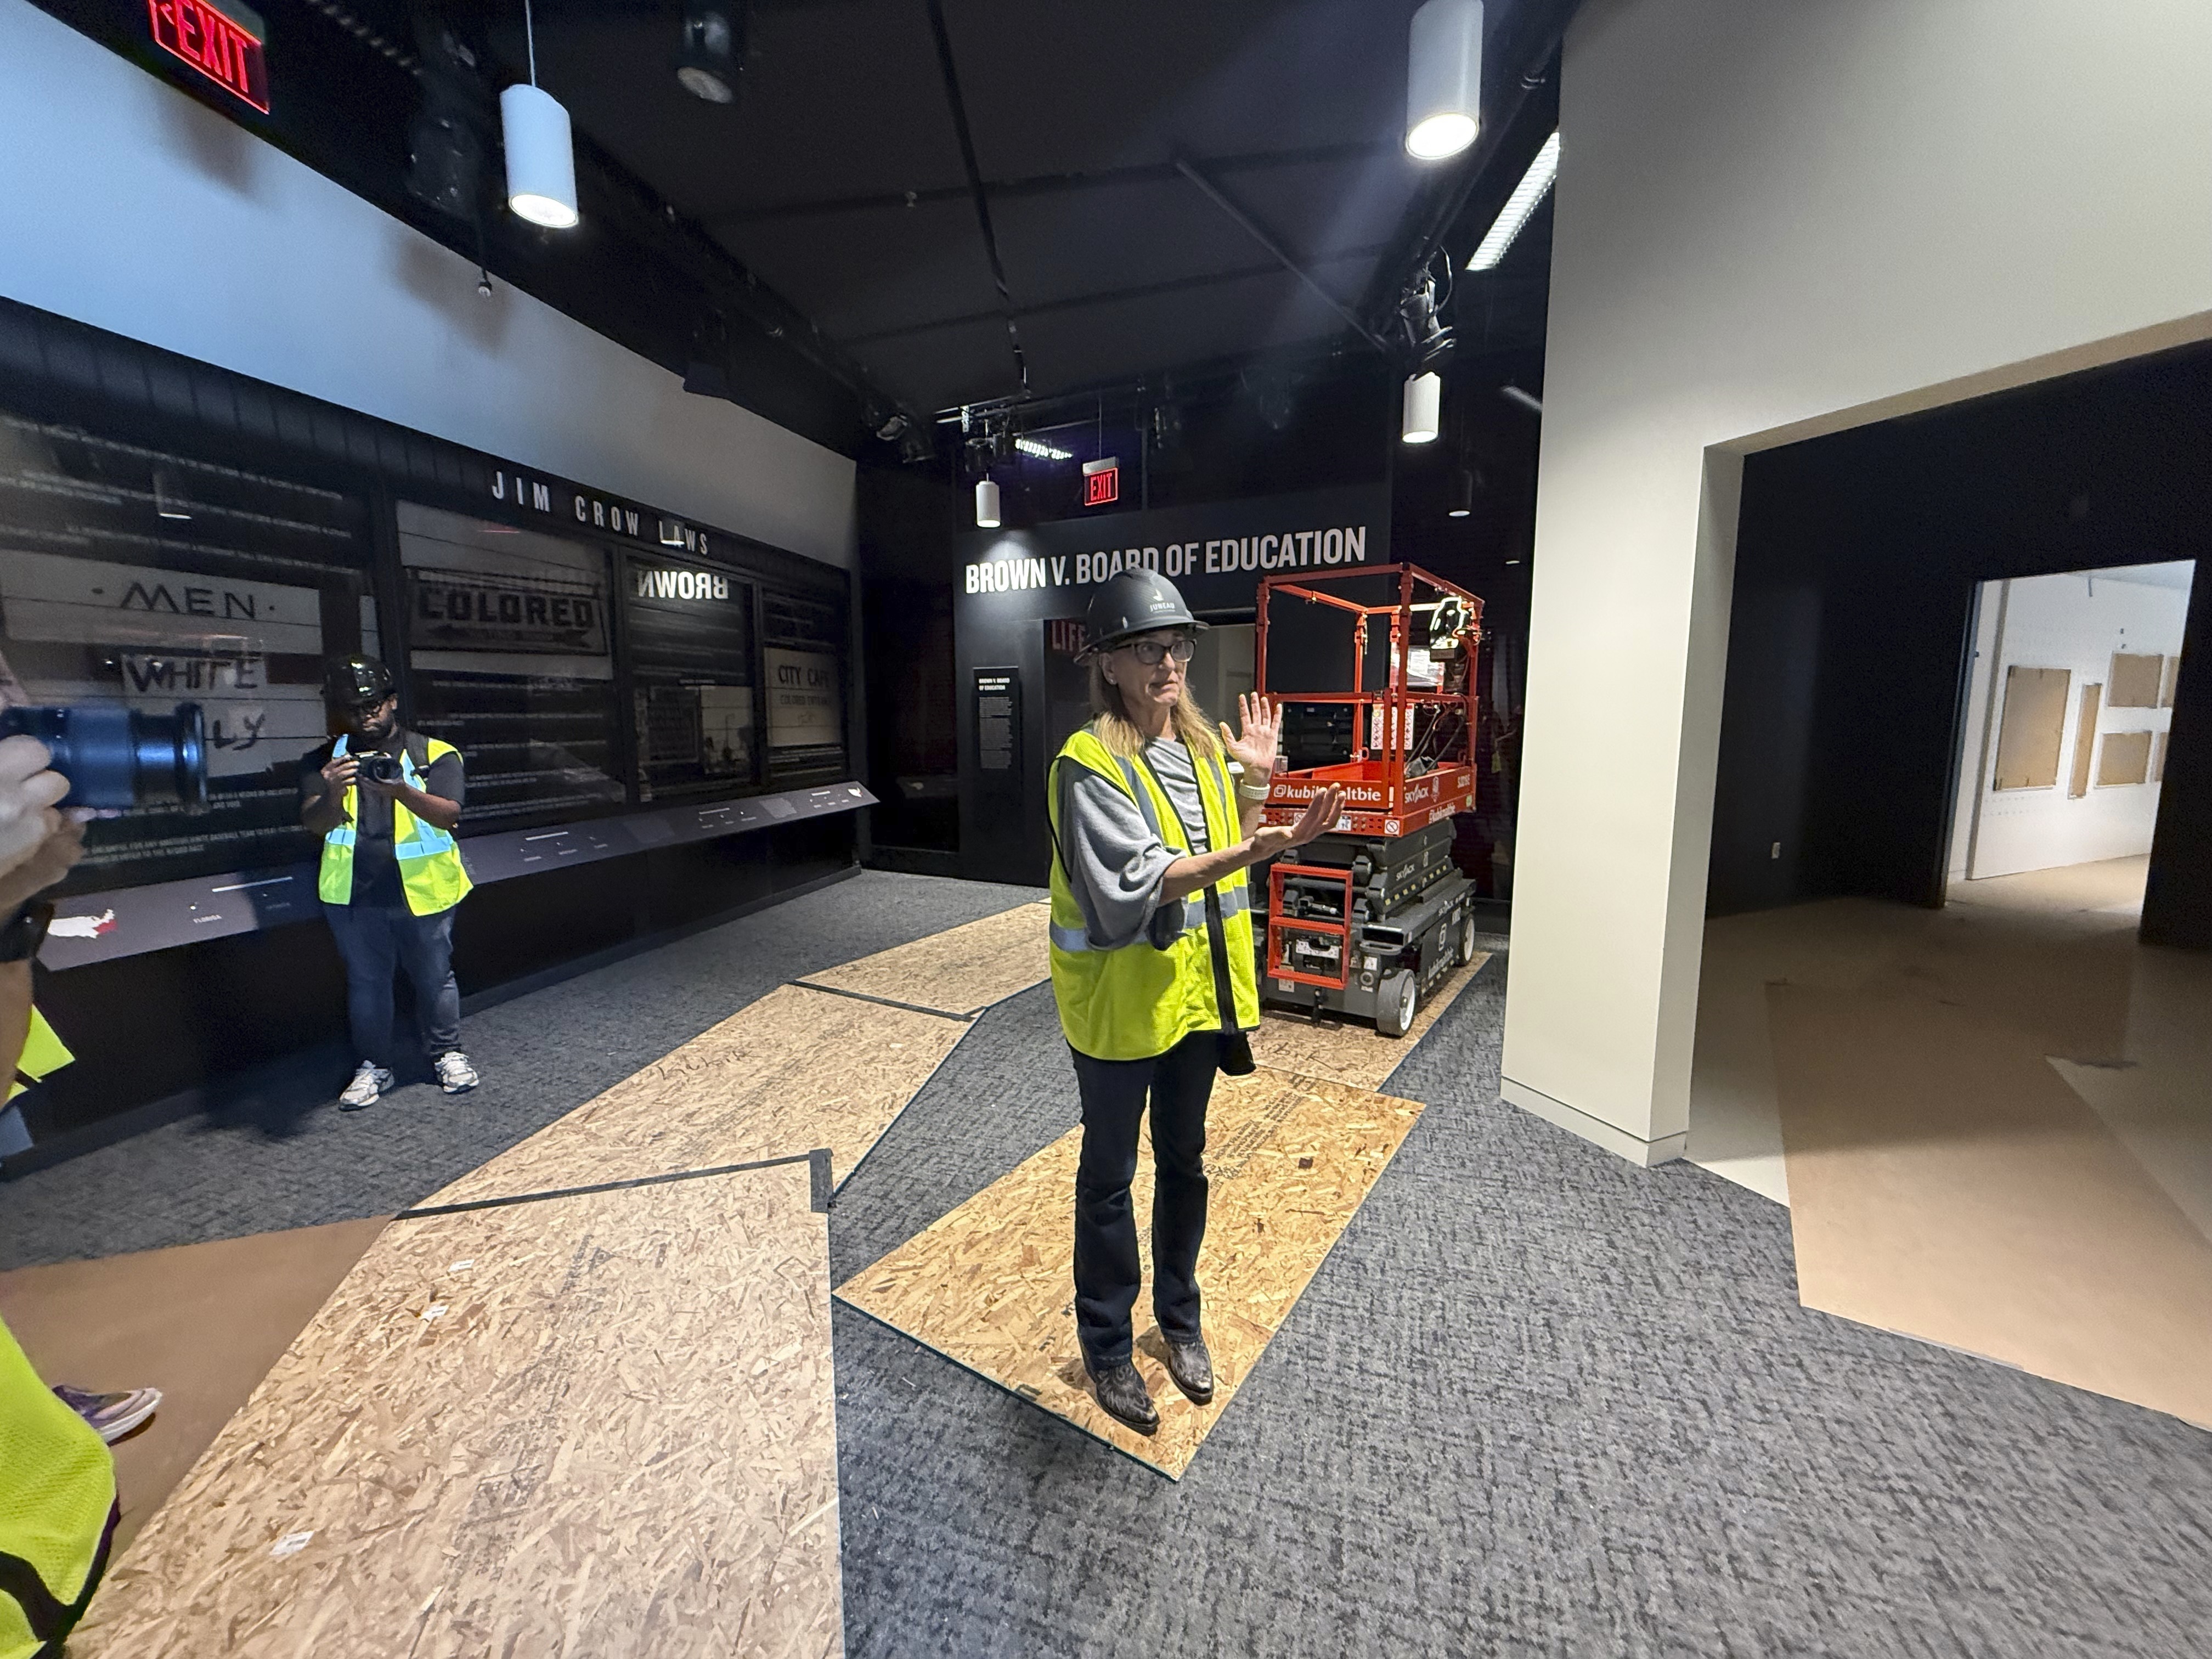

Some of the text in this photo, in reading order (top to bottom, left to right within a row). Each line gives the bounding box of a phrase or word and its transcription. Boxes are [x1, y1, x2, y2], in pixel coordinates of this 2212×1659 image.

[175, 0, 249, 93] EXIT
[1091, 472, 1113, 501] EXIT
[492, 471, 708, 555] JIM CROW LAWS
[966, 526, 1366, 594] BROWN V. BOARD OF EDUCATION
[120, 582, 256, 619] MEN
[418, 588, 596, 629] COLORED
[1149, 602, 1176, 613] JUNEAU
[126, 657, 262, 692] WHITE
[778, 664, 802, 685] CITY
